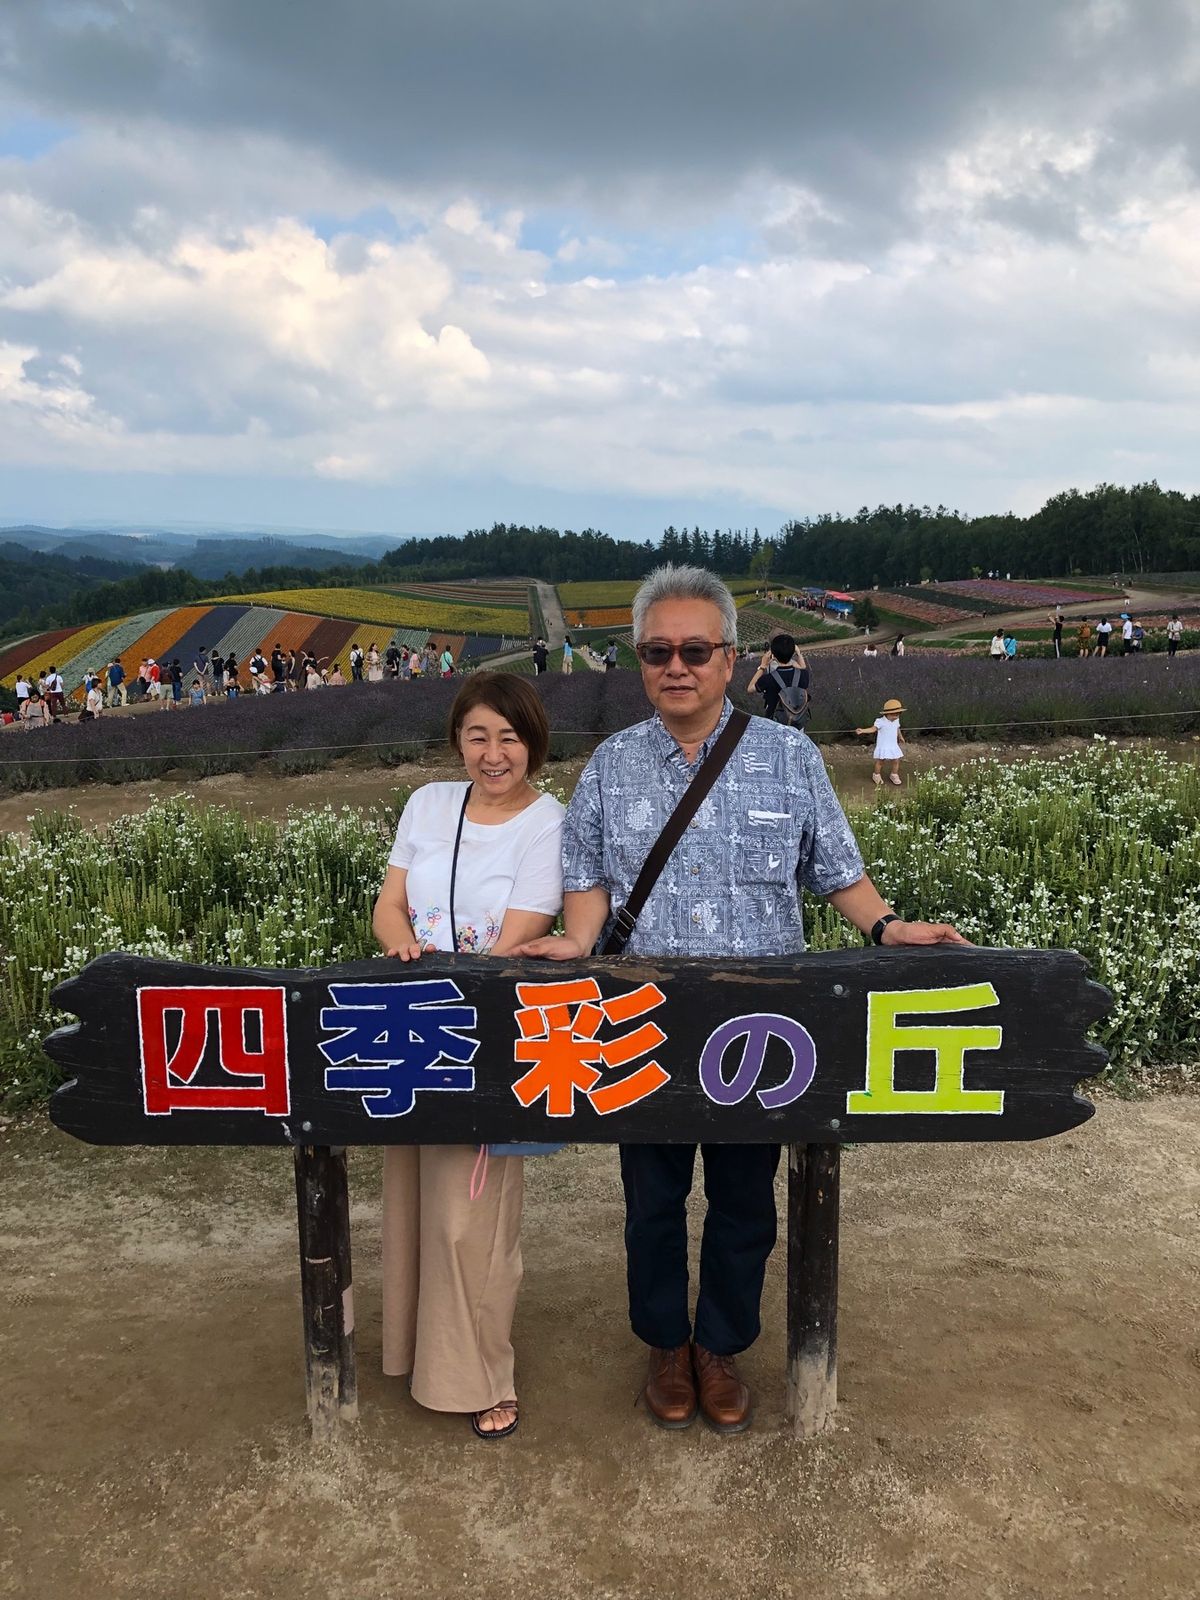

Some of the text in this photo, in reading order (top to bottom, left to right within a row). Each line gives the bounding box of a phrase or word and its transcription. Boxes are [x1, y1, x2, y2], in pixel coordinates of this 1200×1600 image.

[136, 978, 1005, 1119] 四季彩の丘
